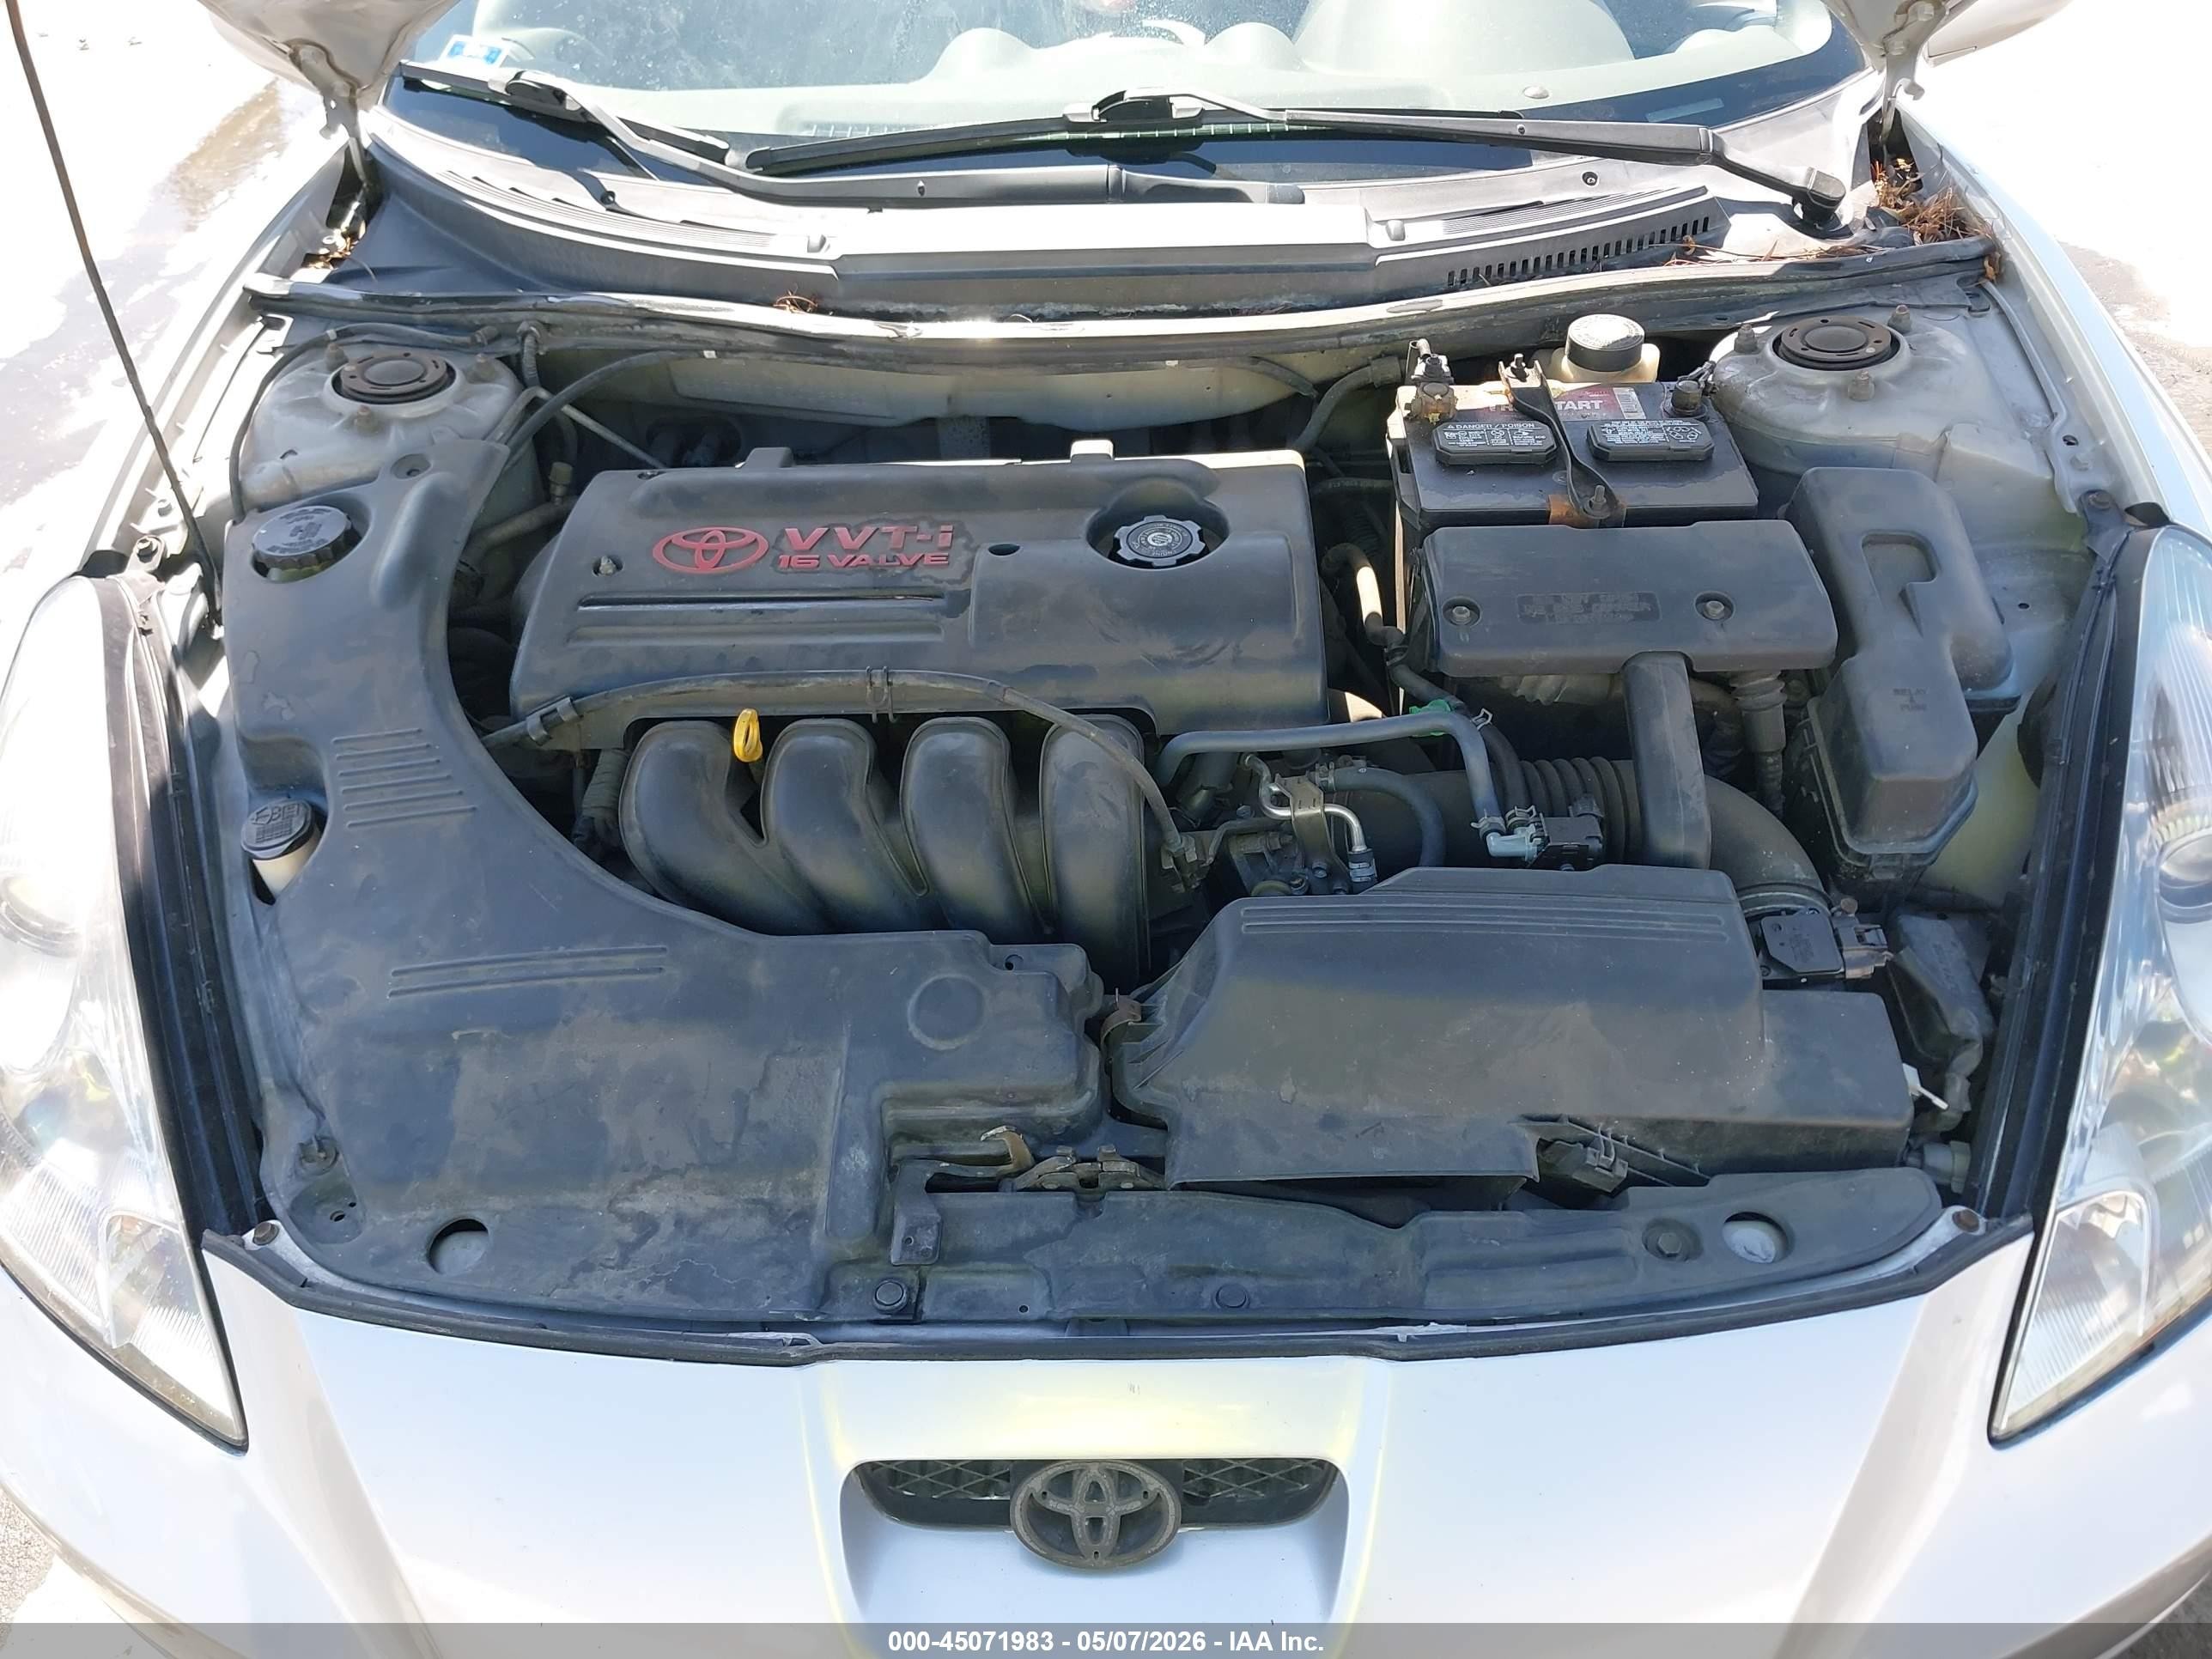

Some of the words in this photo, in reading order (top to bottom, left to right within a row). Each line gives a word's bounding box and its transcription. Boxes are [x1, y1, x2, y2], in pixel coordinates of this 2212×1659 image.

[1553, 399, 1604, 410] TART
[785, 525, 954, 550] VVT-i
[778, 555, 820, 569] 16
[827, 552, 950, 568] VALVE
